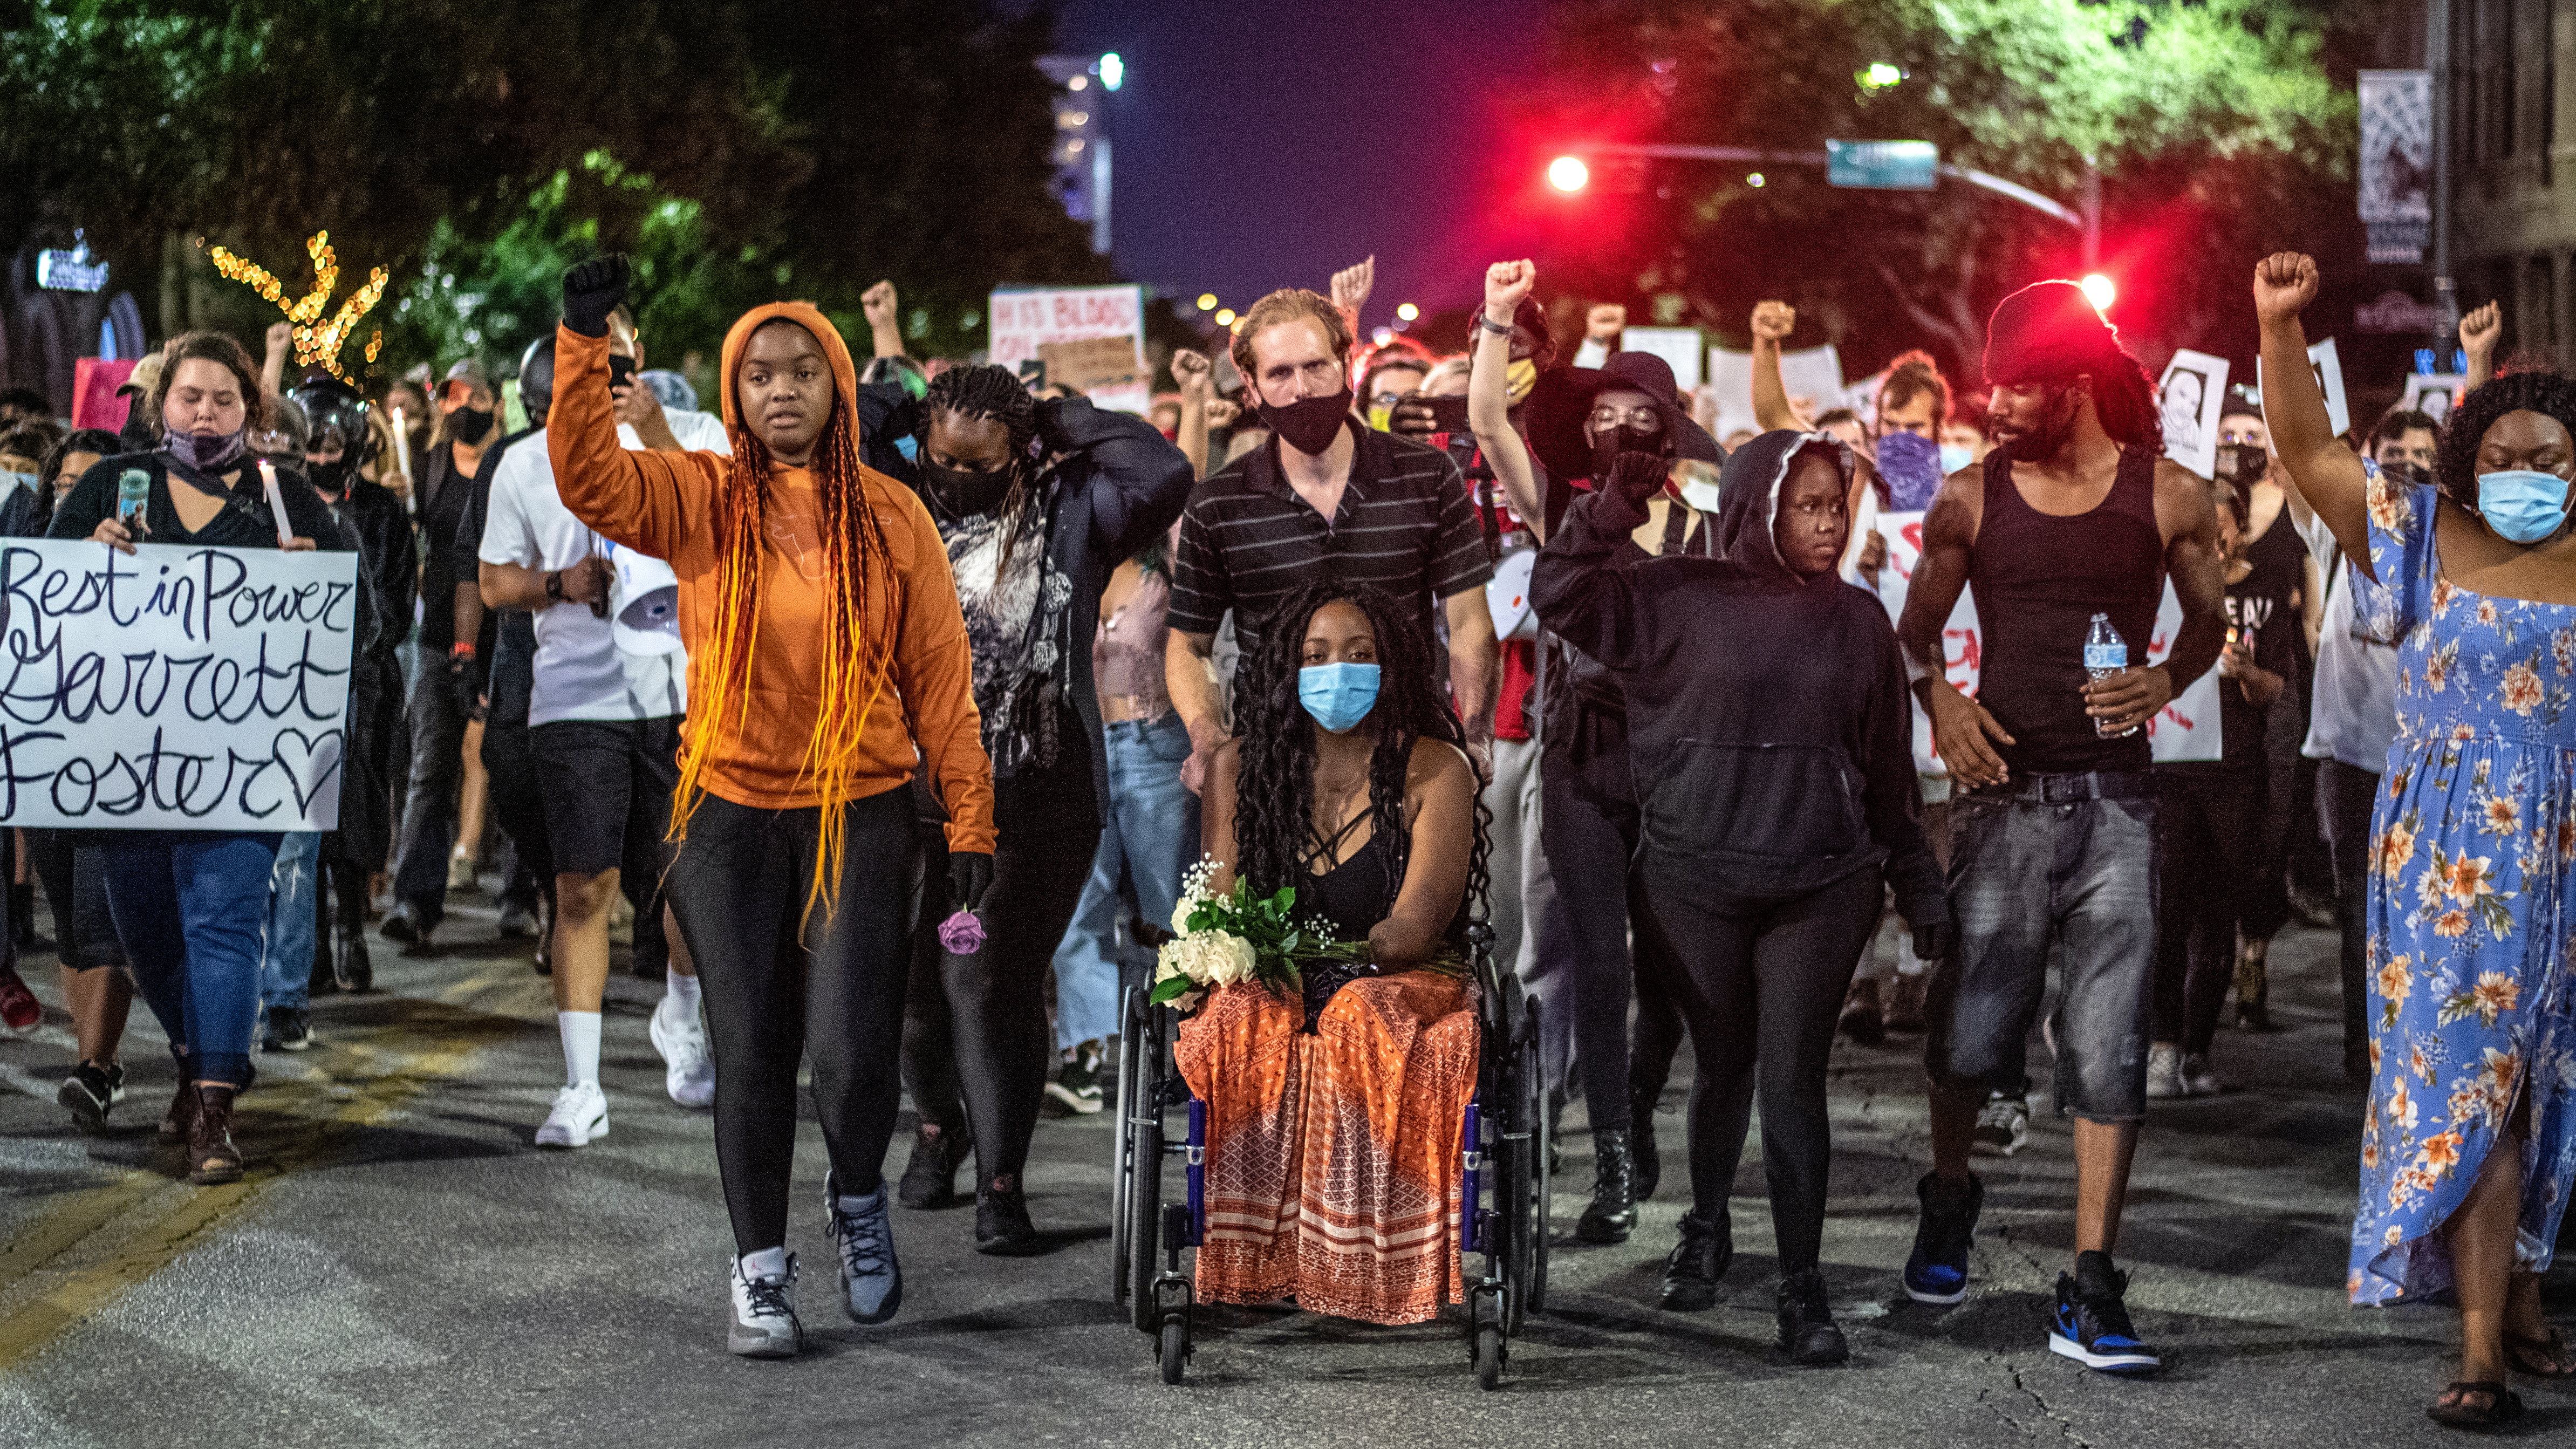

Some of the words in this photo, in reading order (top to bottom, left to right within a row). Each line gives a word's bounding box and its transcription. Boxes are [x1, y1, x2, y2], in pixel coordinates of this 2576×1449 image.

[0, 543, 139, 651] Rest
[145, 565, 195, 641] in
[187, 549, 353, 643] Power
[0, 621, 350, 724] Garrett
[0, 724, 282, 821] Foster
